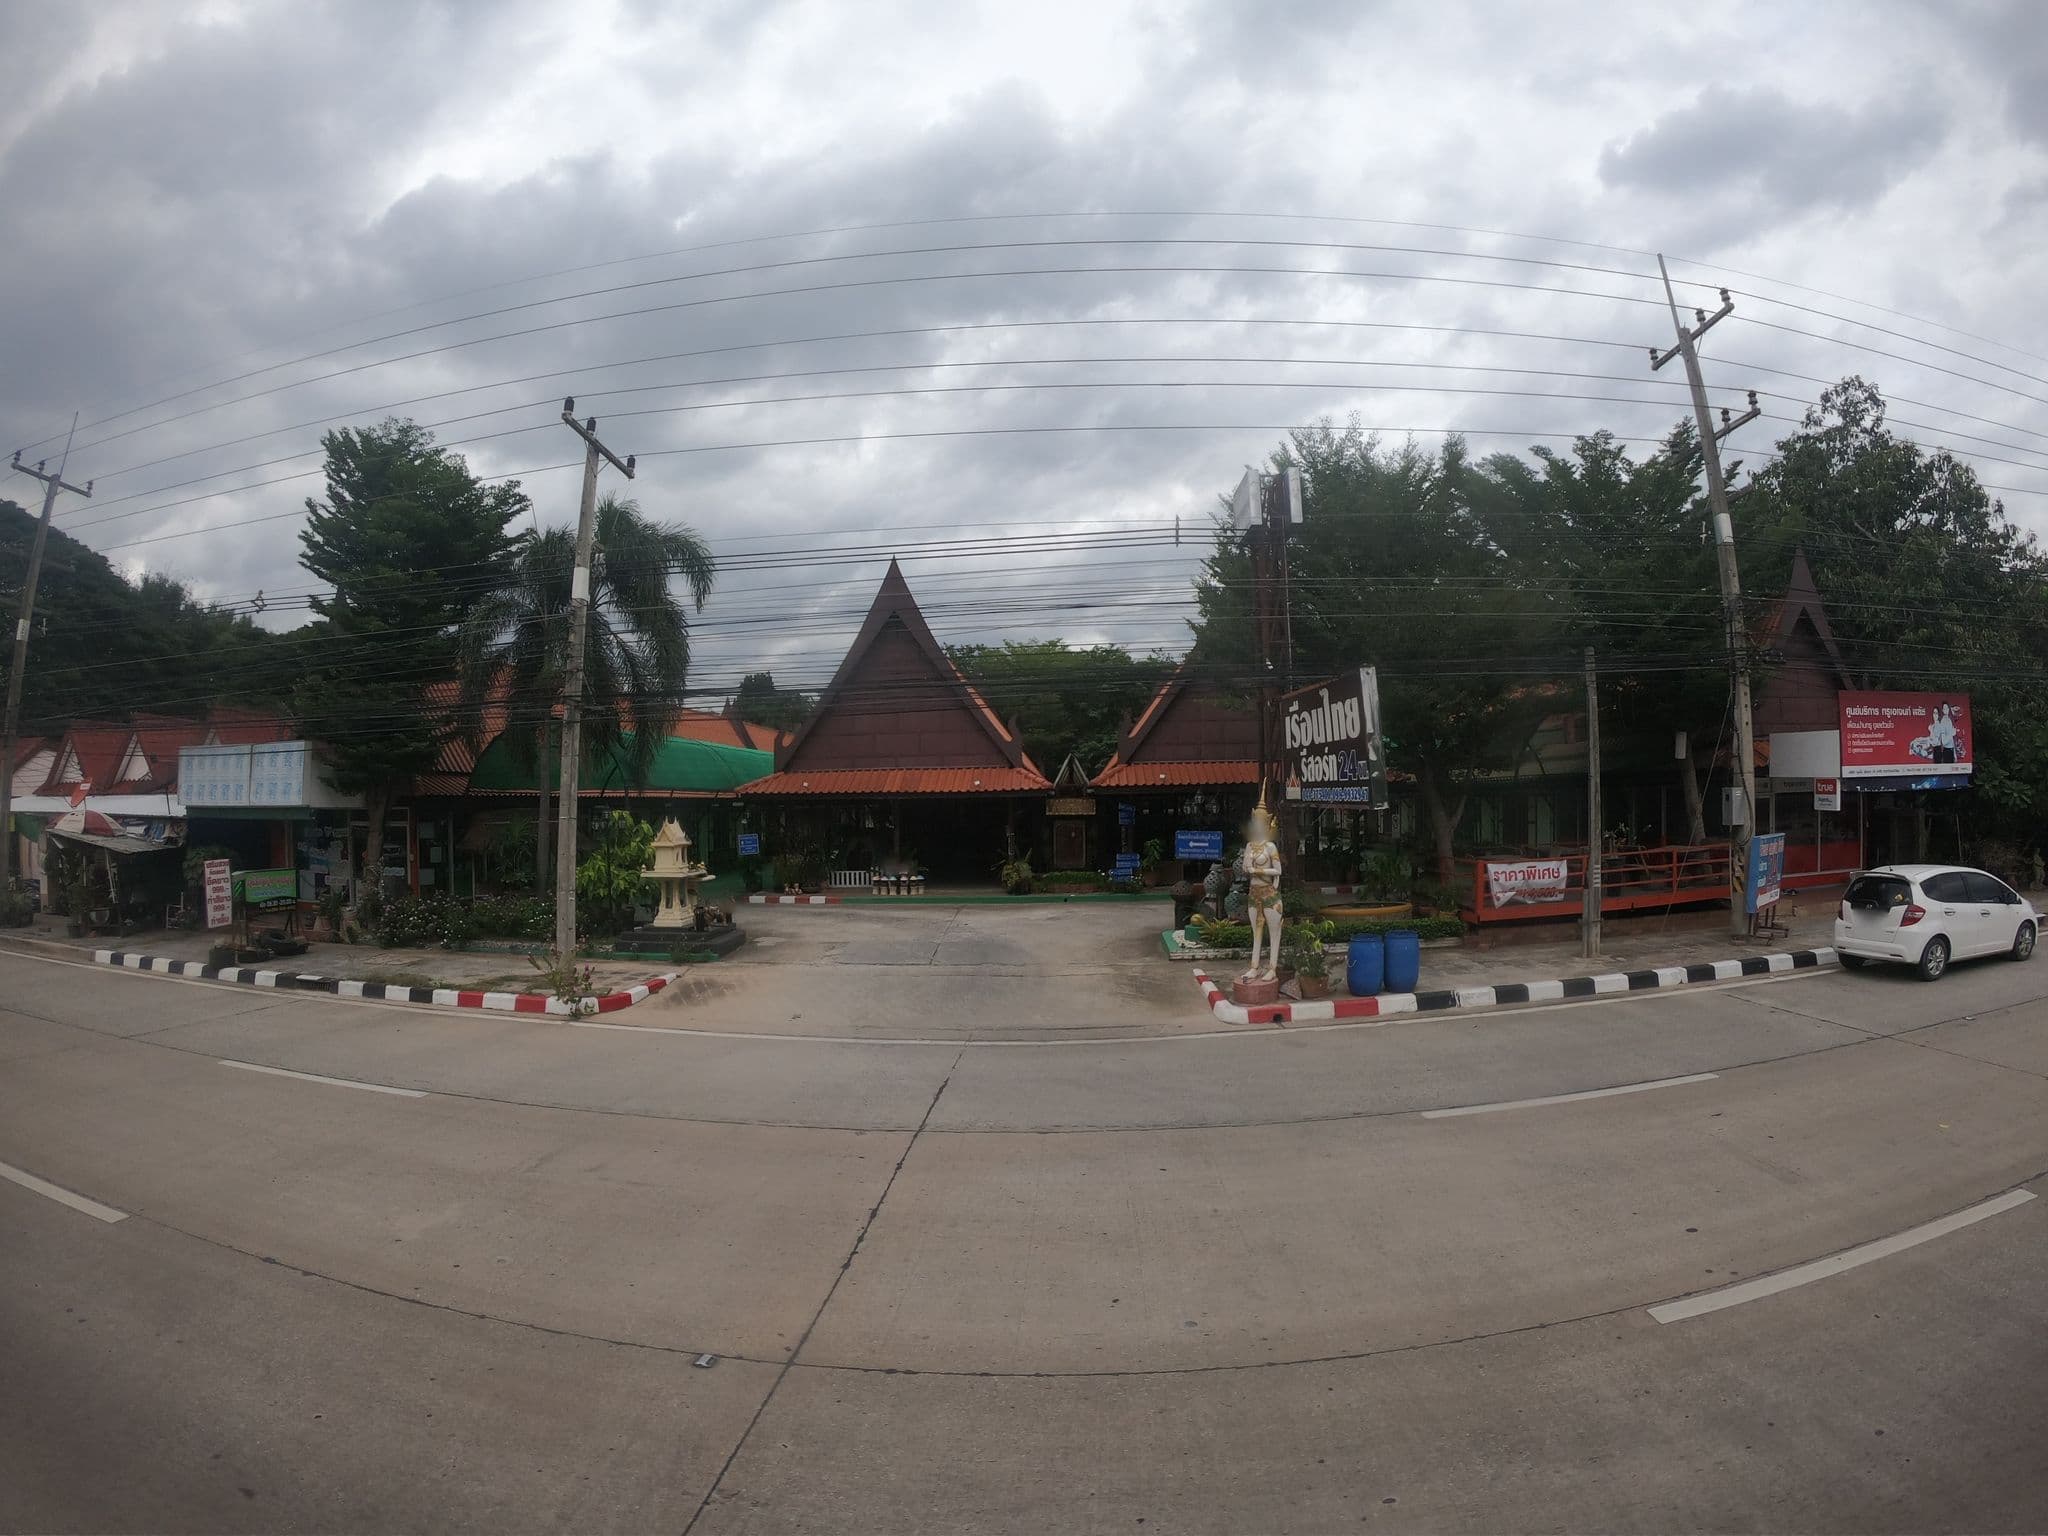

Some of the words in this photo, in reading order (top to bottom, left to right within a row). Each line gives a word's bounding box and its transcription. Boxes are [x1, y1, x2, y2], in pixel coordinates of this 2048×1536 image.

[1285, 688, 1361, 750] เรือนไทย
[1338, 749, 1358, 781] 24
[1817, 782, 1834, 792] true
[1493, 865, 1560, 882] ราคาพิเศษ
